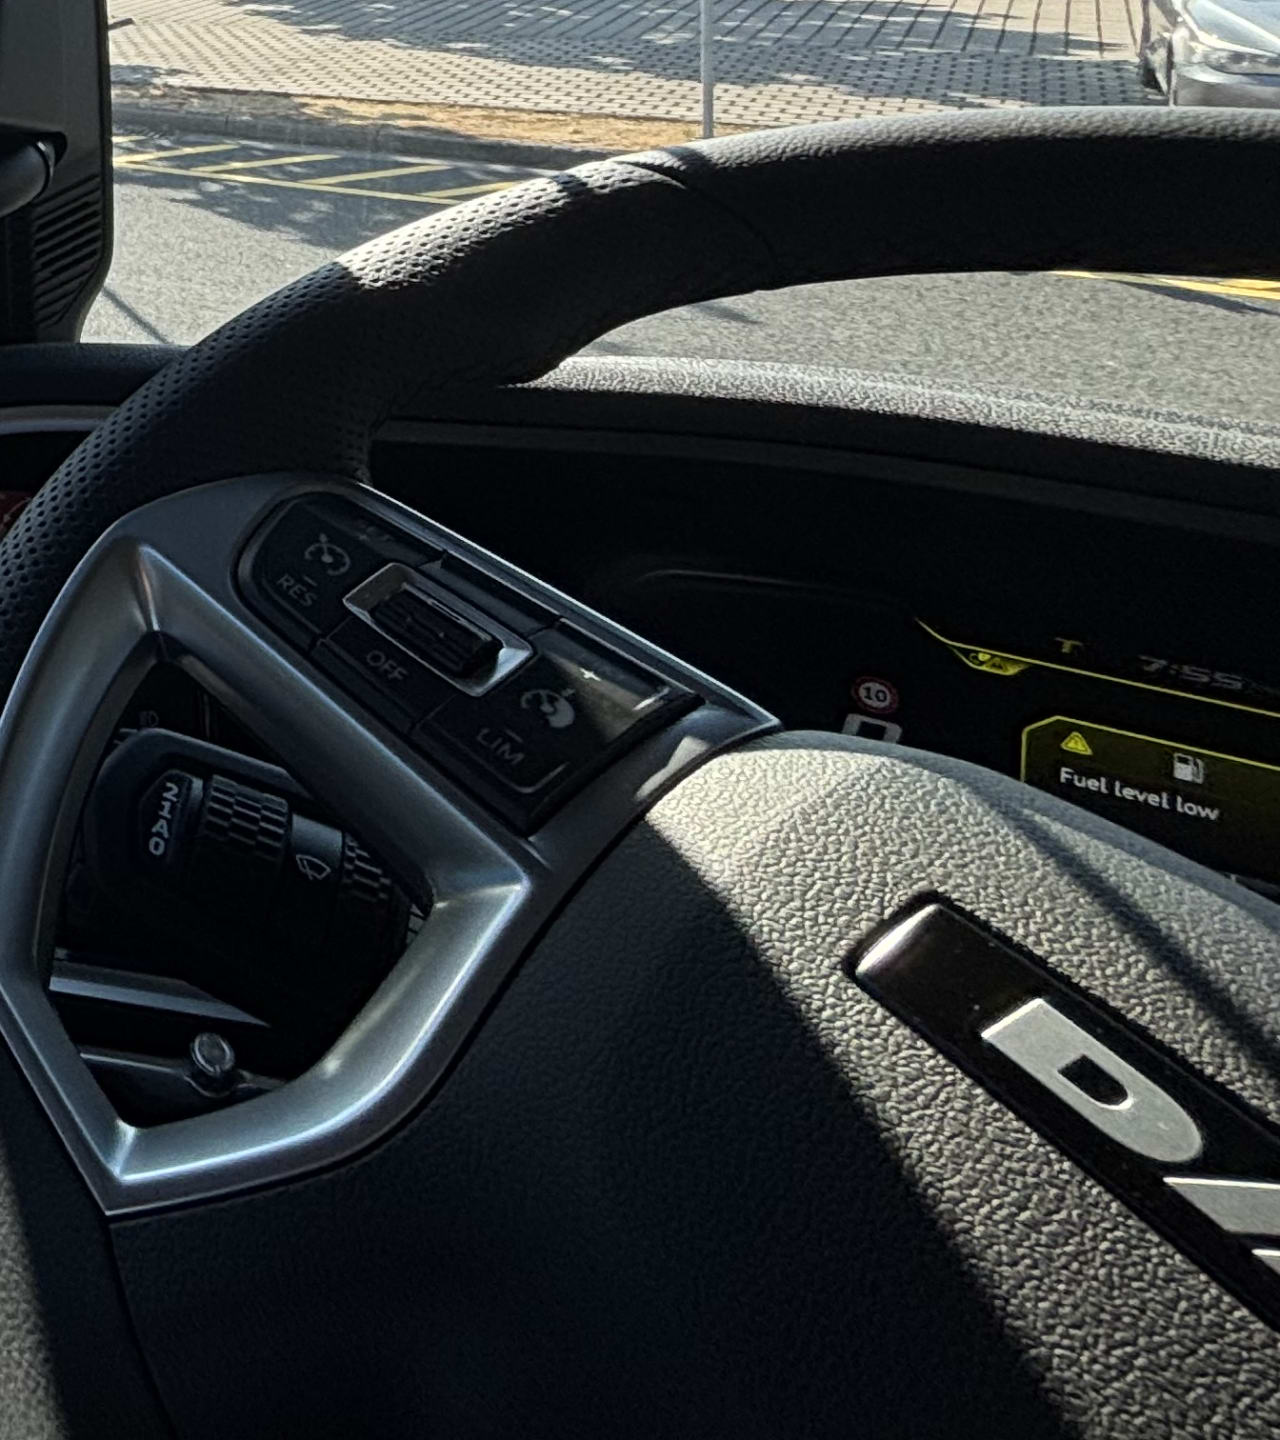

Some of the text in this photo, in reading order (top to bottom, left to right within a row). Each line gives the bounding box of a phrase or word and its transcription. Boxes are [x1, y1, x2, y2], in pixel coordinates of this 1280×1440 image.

[277, 573, 319, 608] RES
[365, 649, 410, 681] OFF
[862, 685, 888, 703] 10
[476, 728, 527, 766] LIM
[1059, 766, 1221, 822] Fuel level low
